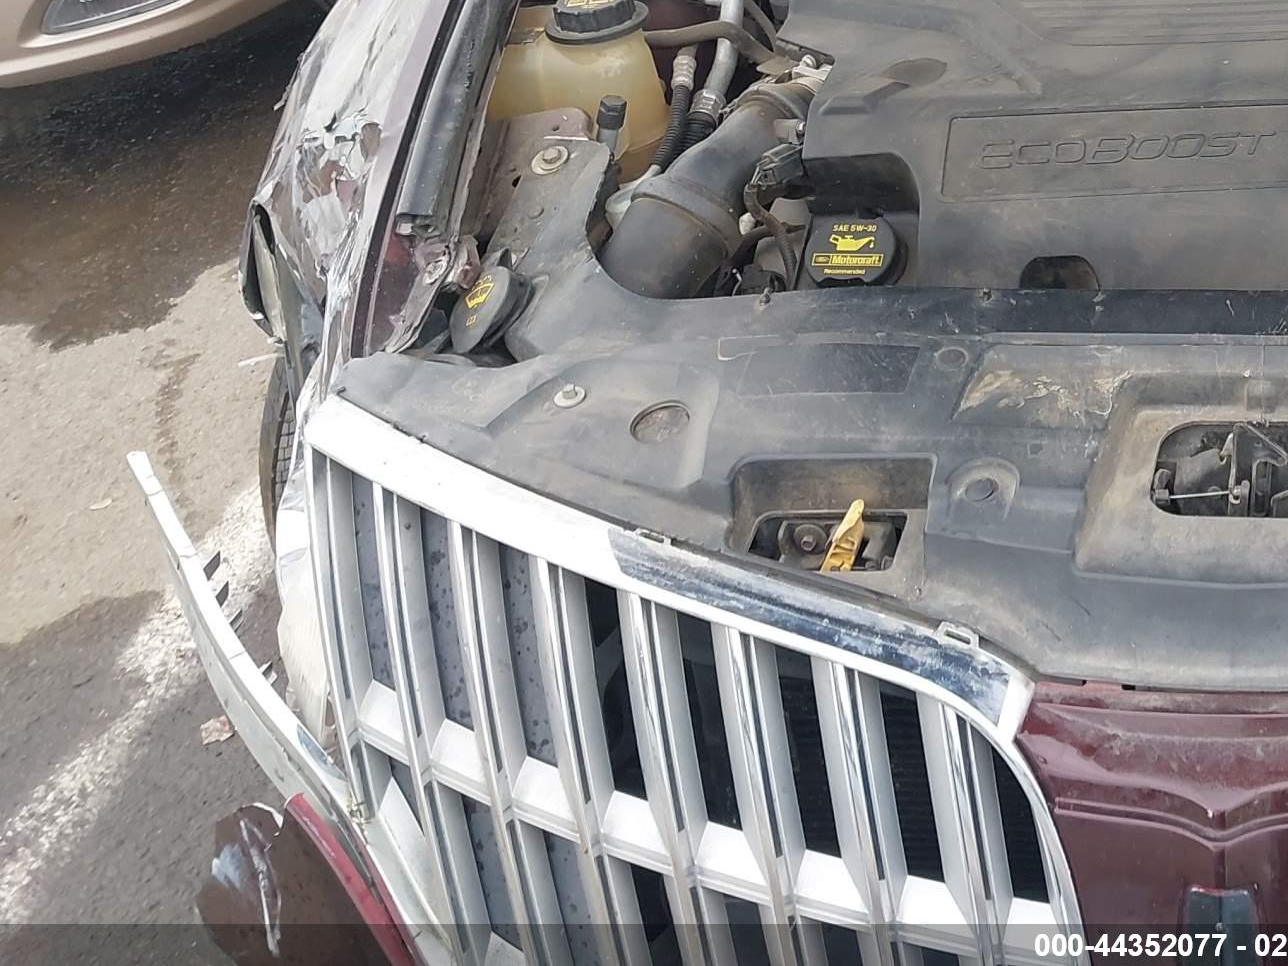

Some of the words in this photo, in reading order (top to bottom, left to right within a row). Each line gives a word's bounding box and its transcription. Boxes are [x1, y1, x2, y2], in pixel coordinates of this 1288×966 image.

[832, 224, 849, 232] SAE
[850, 224, 878, 232] 5W-30
[831, 255, 881, 264] Motorcraft
